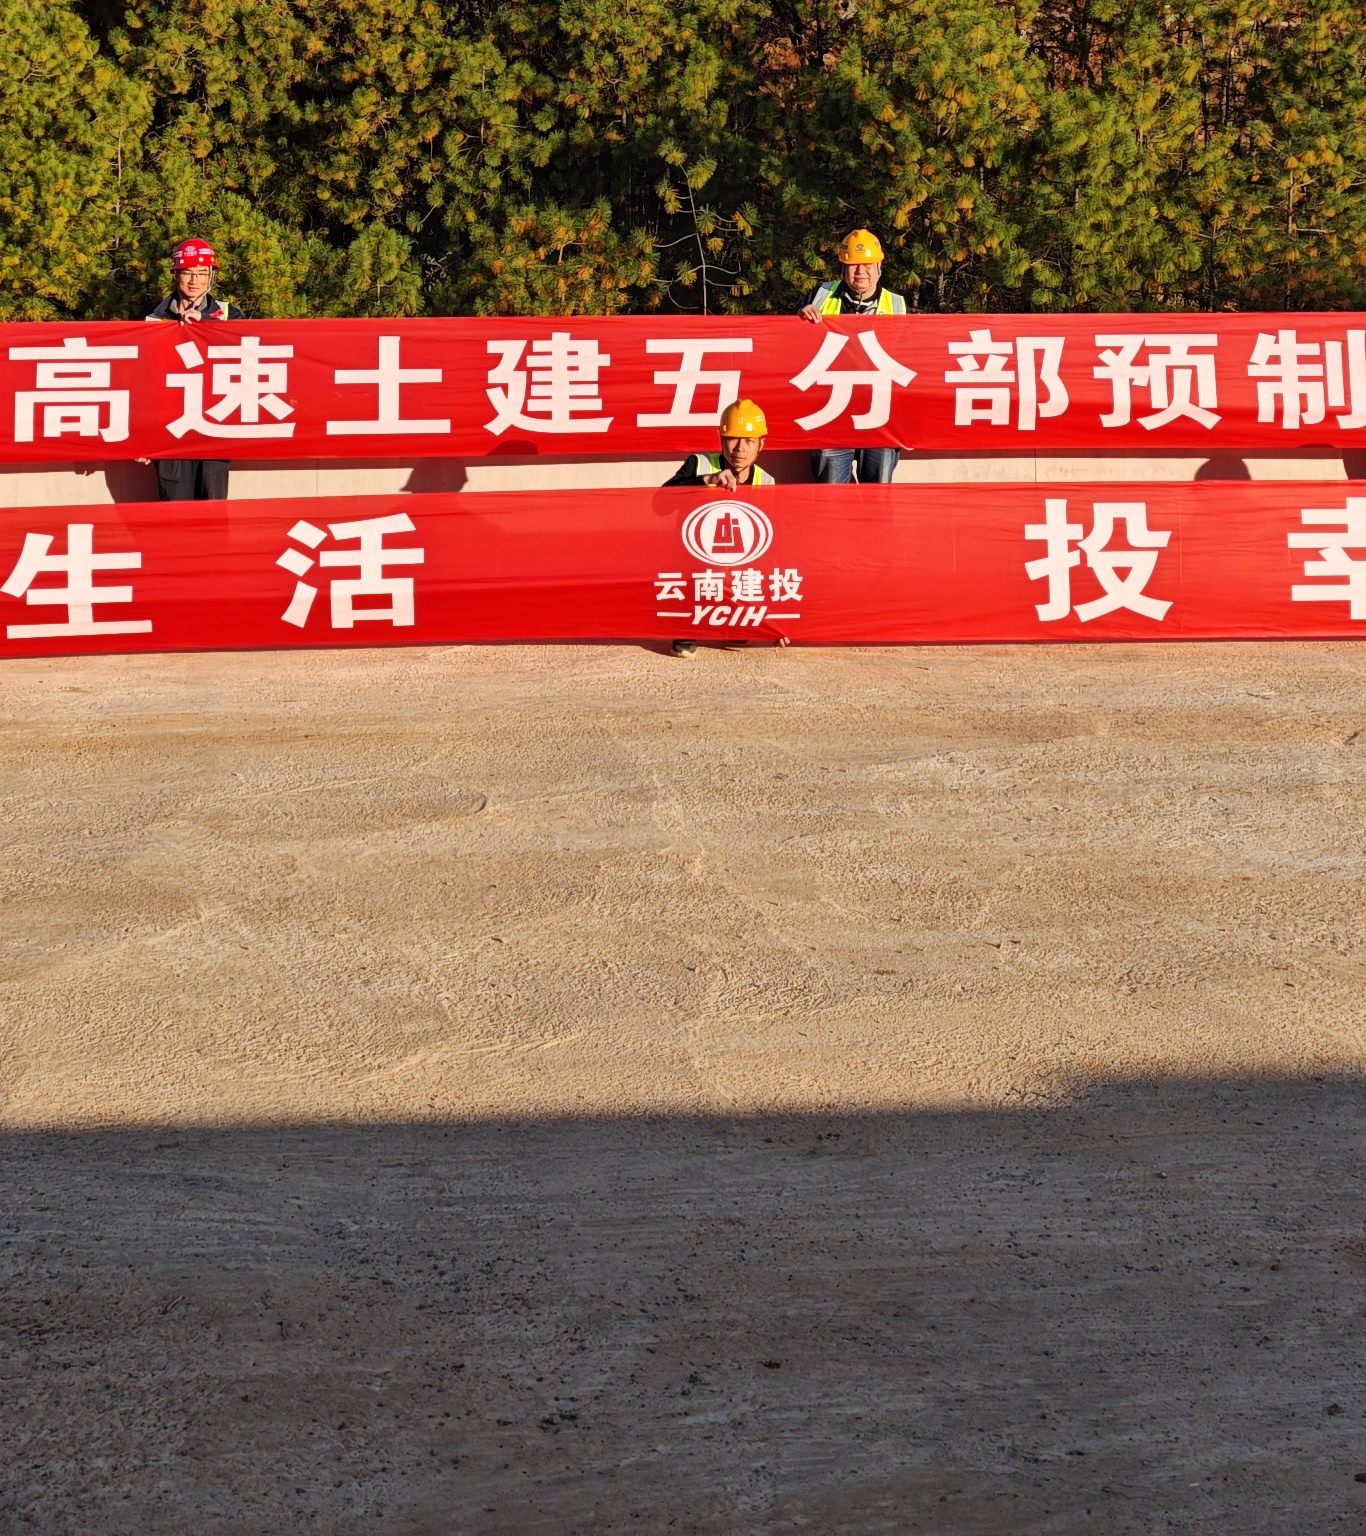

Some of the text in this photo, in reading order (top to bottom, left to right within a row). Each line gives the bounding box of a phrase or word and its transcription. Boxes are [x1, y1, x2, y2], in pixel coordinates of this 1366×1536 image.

[653, 567, 803, 602] 云南建投
[691, 605, 768, 627] YCIH
